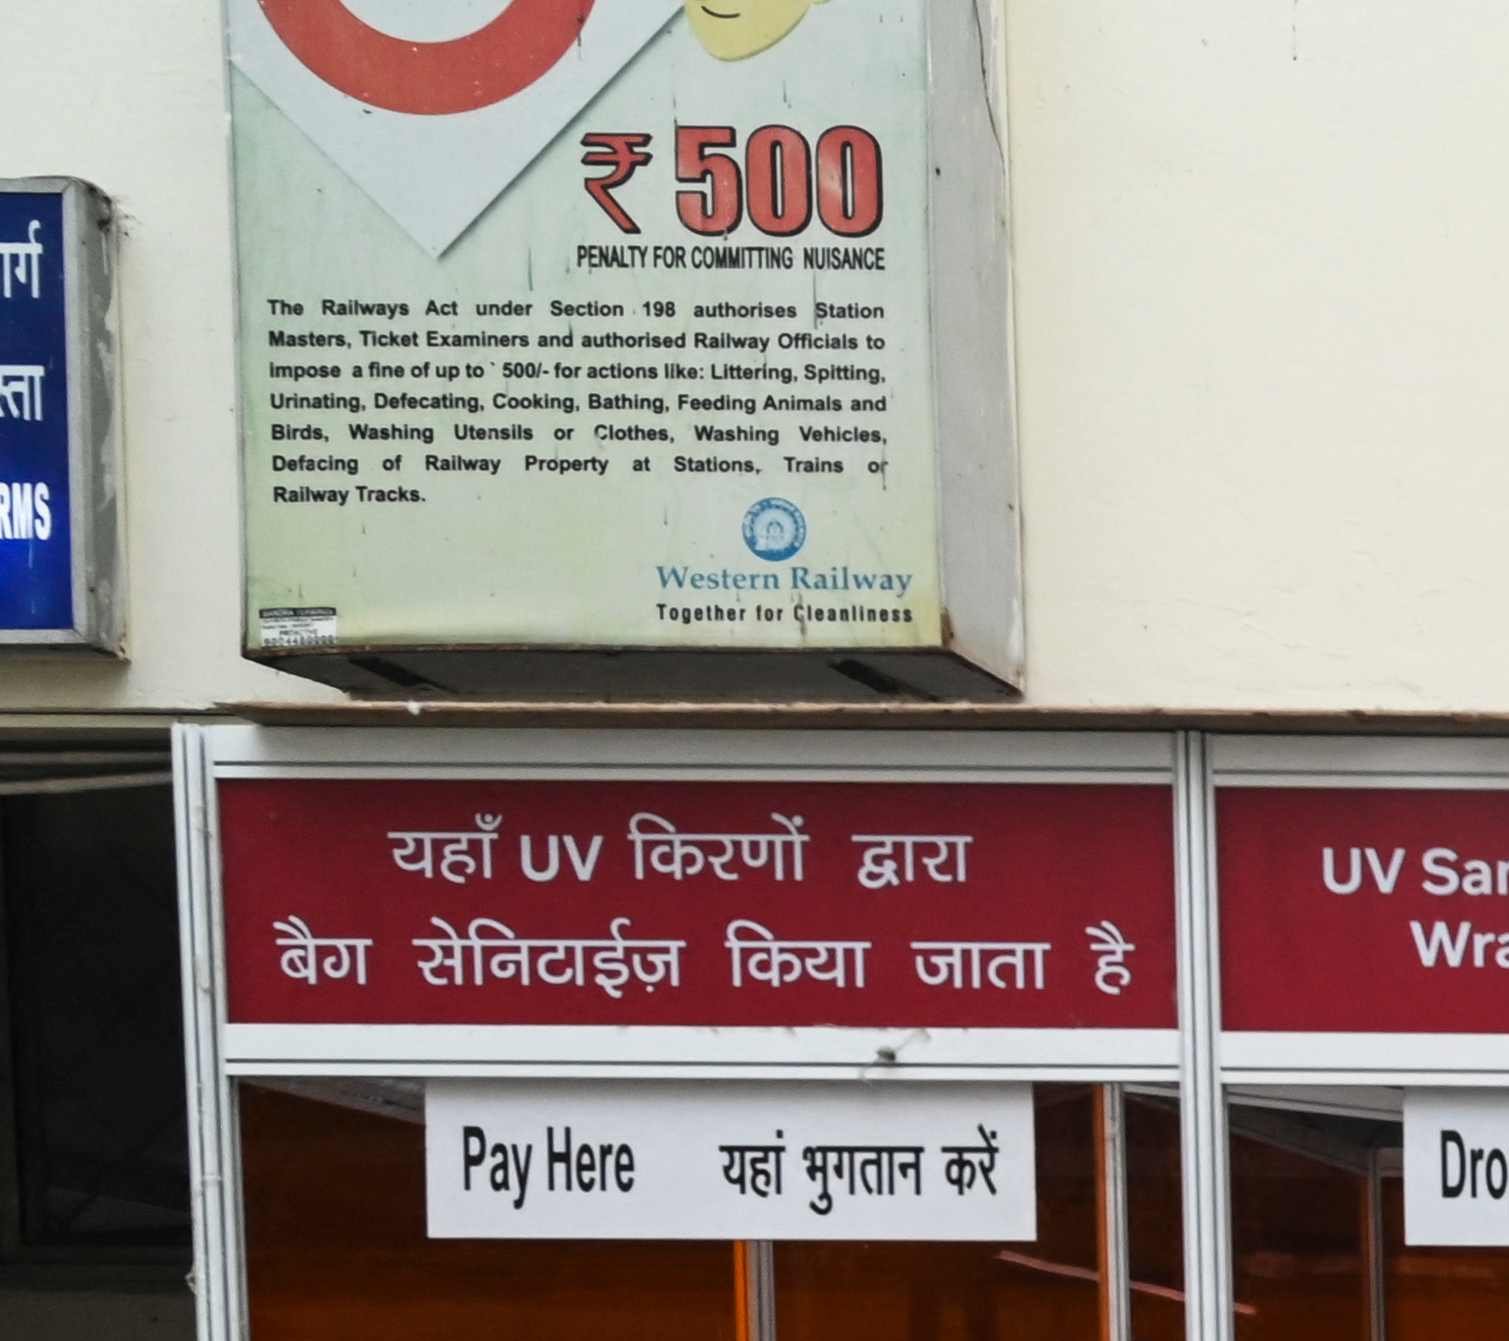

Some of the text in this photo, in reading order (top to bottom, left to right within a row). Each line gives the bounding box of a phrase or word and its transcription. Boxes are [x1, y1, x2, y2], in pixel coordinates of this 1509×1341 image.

[674, 124, 884, 238] 500
[577, 245, 886, 270] PENALTY FOR COMMITTING NUISANCE
[268, 299, 885, 320] The Railways Act under Section 198 authorises Station
[268, 330, 859, 353] Masters, Ticket Examiners authorised Railway Officials
[269, 361, 887, 385] impose fine 500/- actions like: Littering, Spitting,
[270, 393, 843, 415] Urinating, Defecating, Cooking, Bathing, Feeding Animals
[271, 424, 888, 446] Birds, Washing Utensils Clothes, Washing Vehicles,
[271, 455, 845, 476] Defacing Railway Property Stations, Trains
[273, 486, 427, 507] Railway Tracks.
[656, 565, 913, 599] Western Railway
[656, 603, 913, 624] Together for Cleanliness
[387, 812, 974, 888] यहाँ UV किरणों द्वारा
[1321, 846, 1406, 897] UV
[272, 914, 373, 985] बैग
[724, 919, 873, 990] किया
[910, 941, 1050, 992] जाता
[1084, 920, 1135, 995] है
[462, 1125, 637, 1208] Pay Here
[719, 1125, 1002, 1214] यहां भुगतान करें
